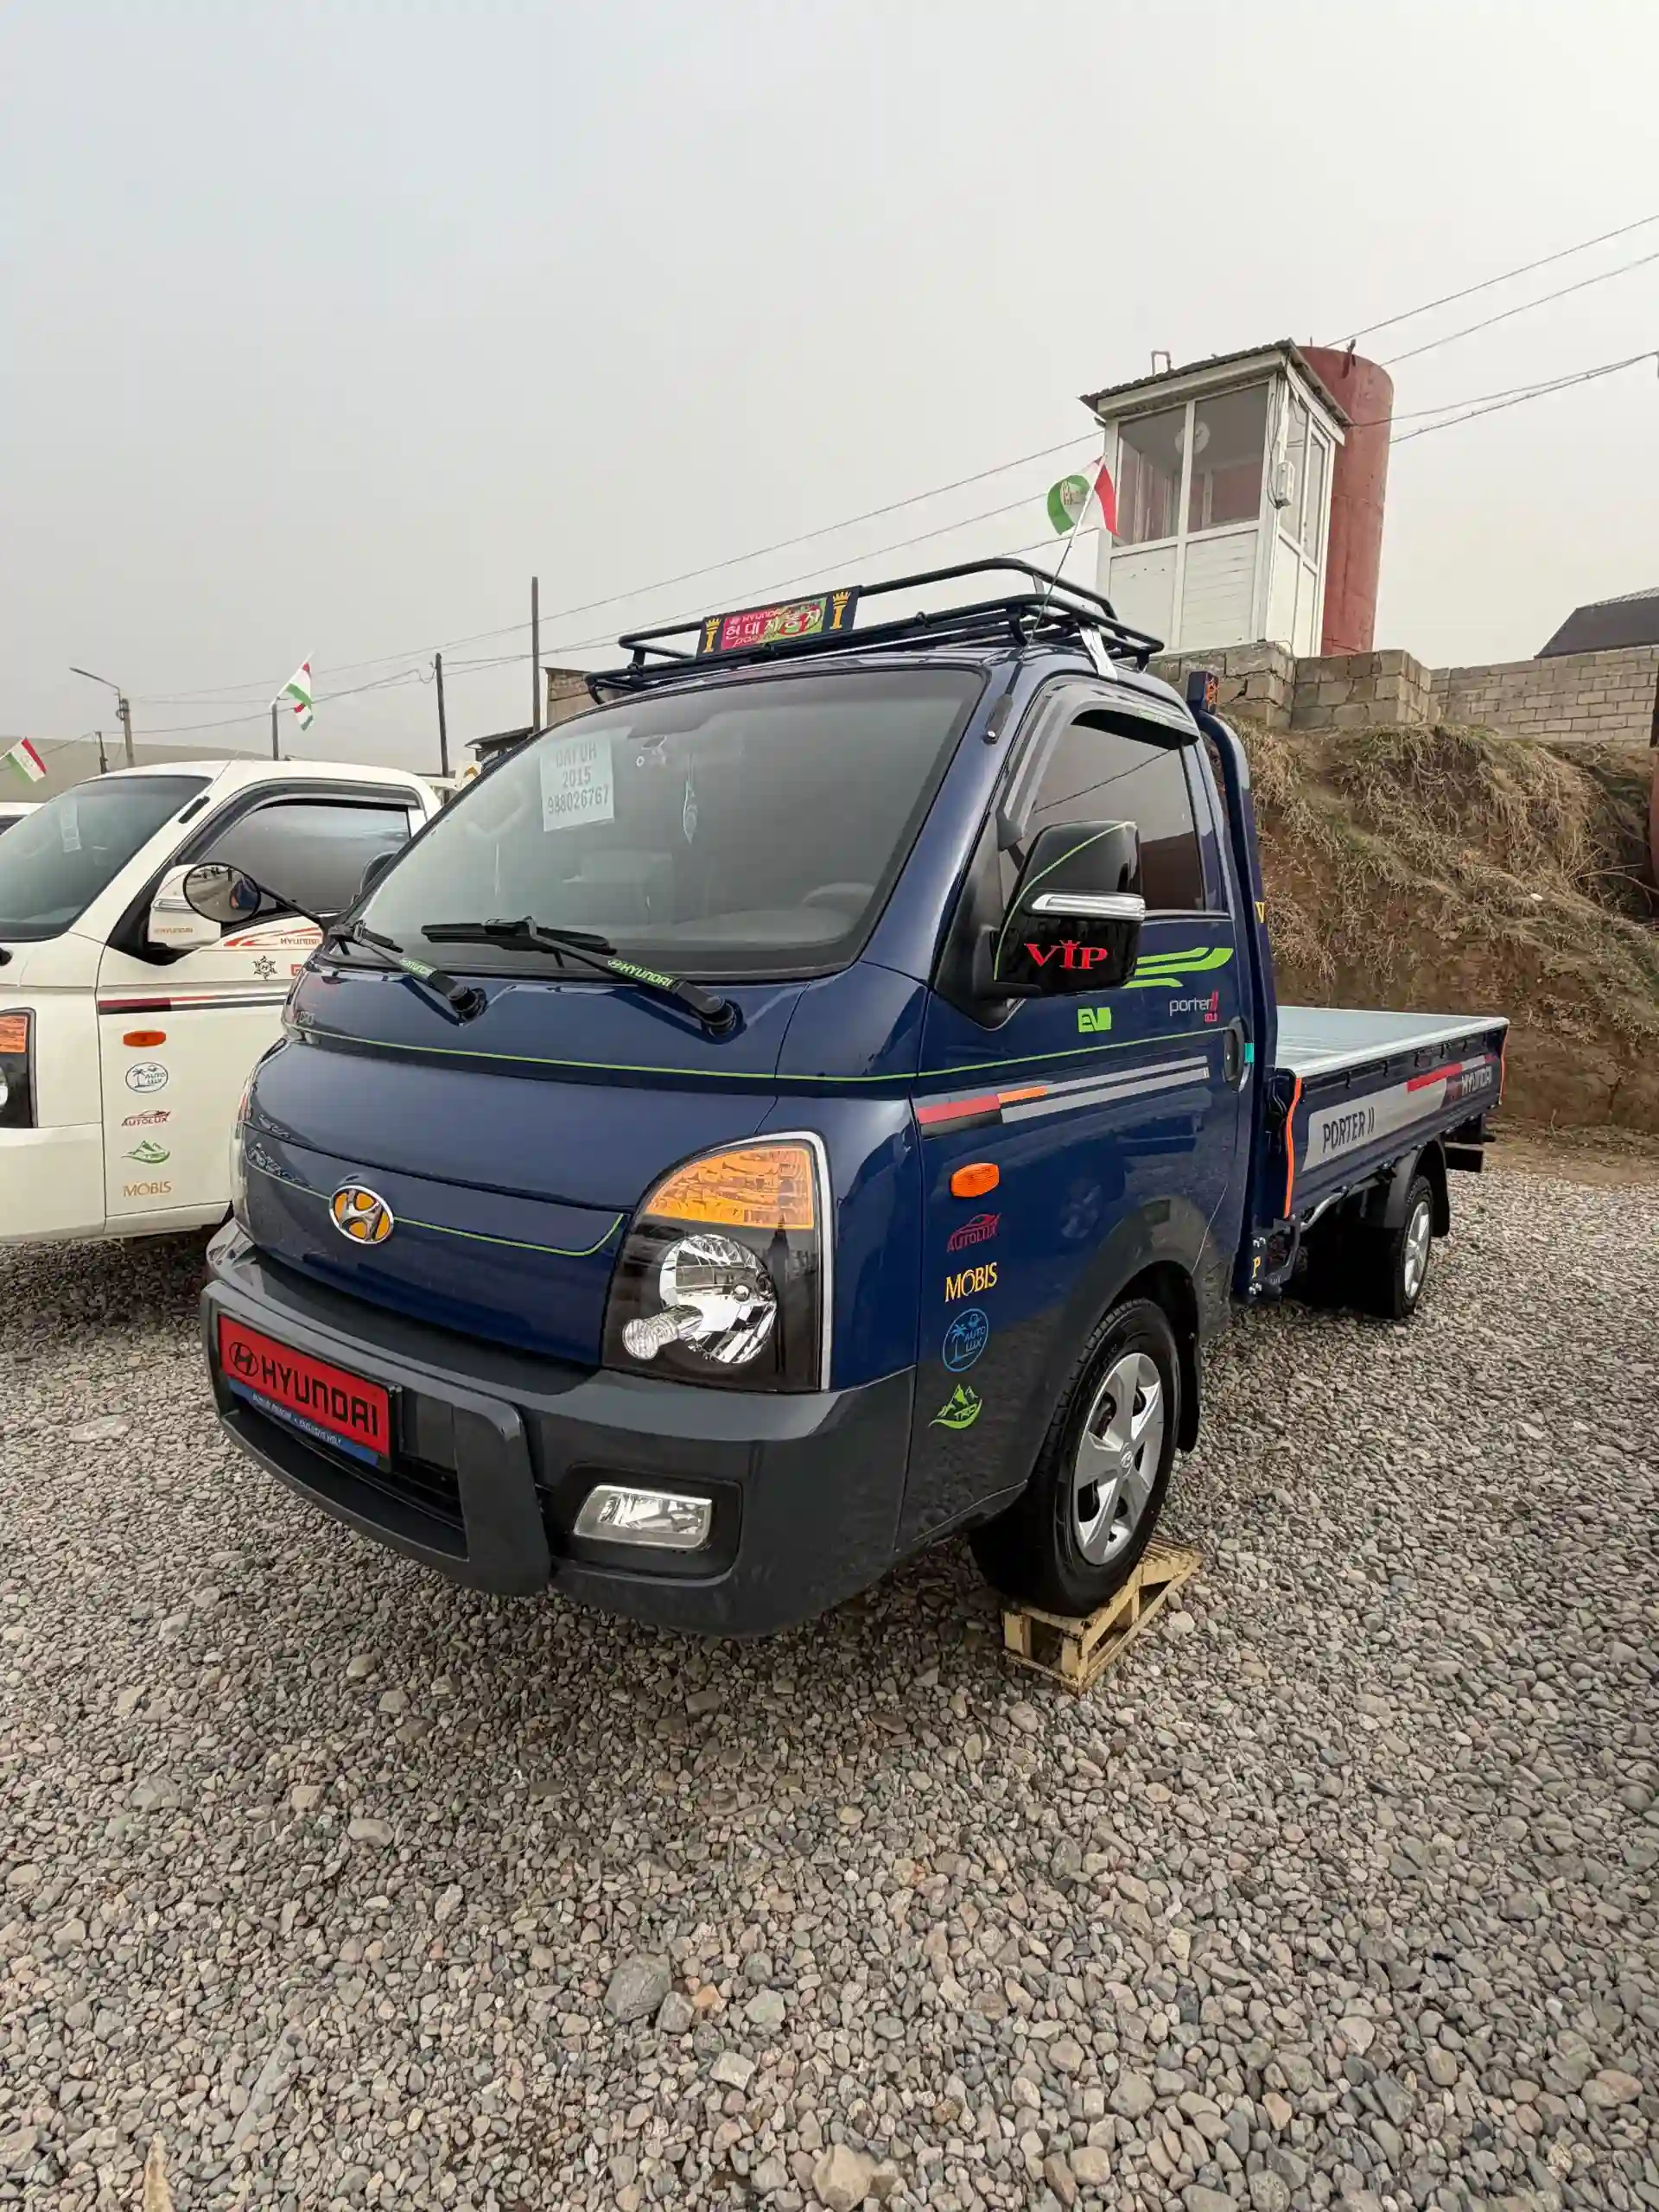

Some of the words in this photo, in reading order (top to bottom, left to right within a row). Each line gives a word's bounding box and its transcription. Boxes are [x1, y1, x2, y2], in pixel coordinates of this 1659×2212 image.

[563, 765, 591, 788] 2015
[1024, 940, 1108, 969] VIP
[620, 963, 675, 988] HYUNDAI
[122, 1115, 168, 1127] AUTOLUX
[1322, 1109, 1365, 1154] PORTER
[124, 1180, 172, 1197] MOBIS
[946, 1224, 998, 1253] AUTOLUX
[944, 1262, 997, 1303] MOBIS
[964, 1325, 986, 1342] AUTO
[966, 1337, 982, 1352] LUX
[261, 1354, 378, 1437] HYUNDAI
[954, 1402, 978, 1421] TRD
